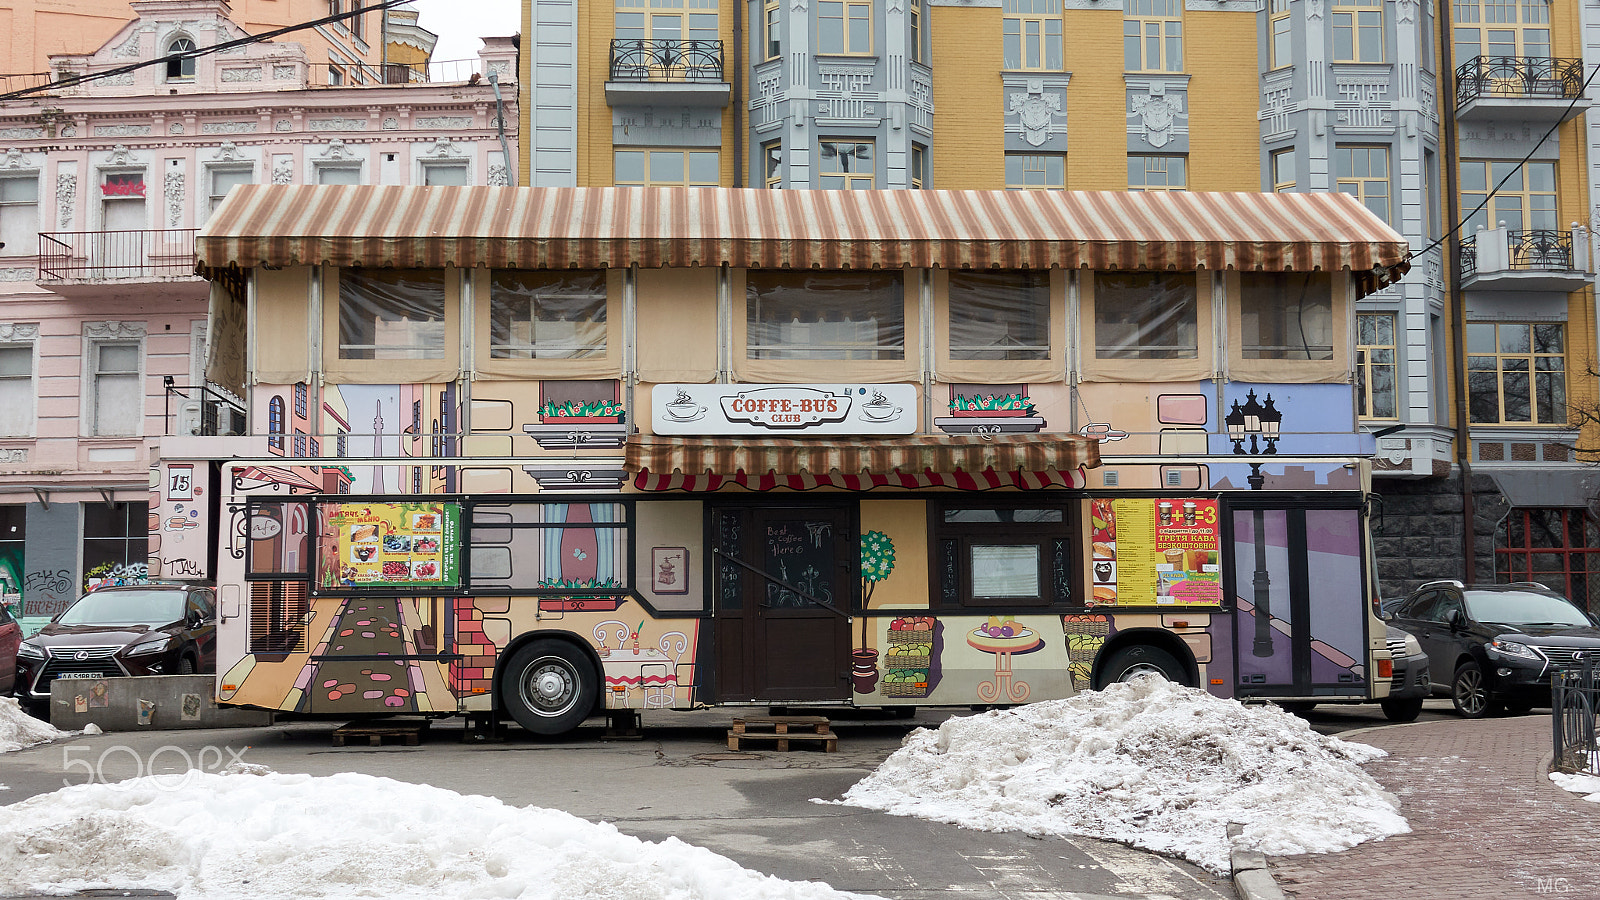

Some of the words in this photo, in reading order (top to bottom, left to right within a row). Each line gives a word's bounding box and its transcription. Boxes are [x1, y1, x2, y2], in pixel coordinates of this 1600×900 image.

[731, 398, 838, 413] COFFE-BUS
[771, 413, 801, 423] CLUB
[170, 474, 190, 492] 15
[329, 510, 359, 518] ДИТЯЧЕ
[767, 525, 787, 536] Best
